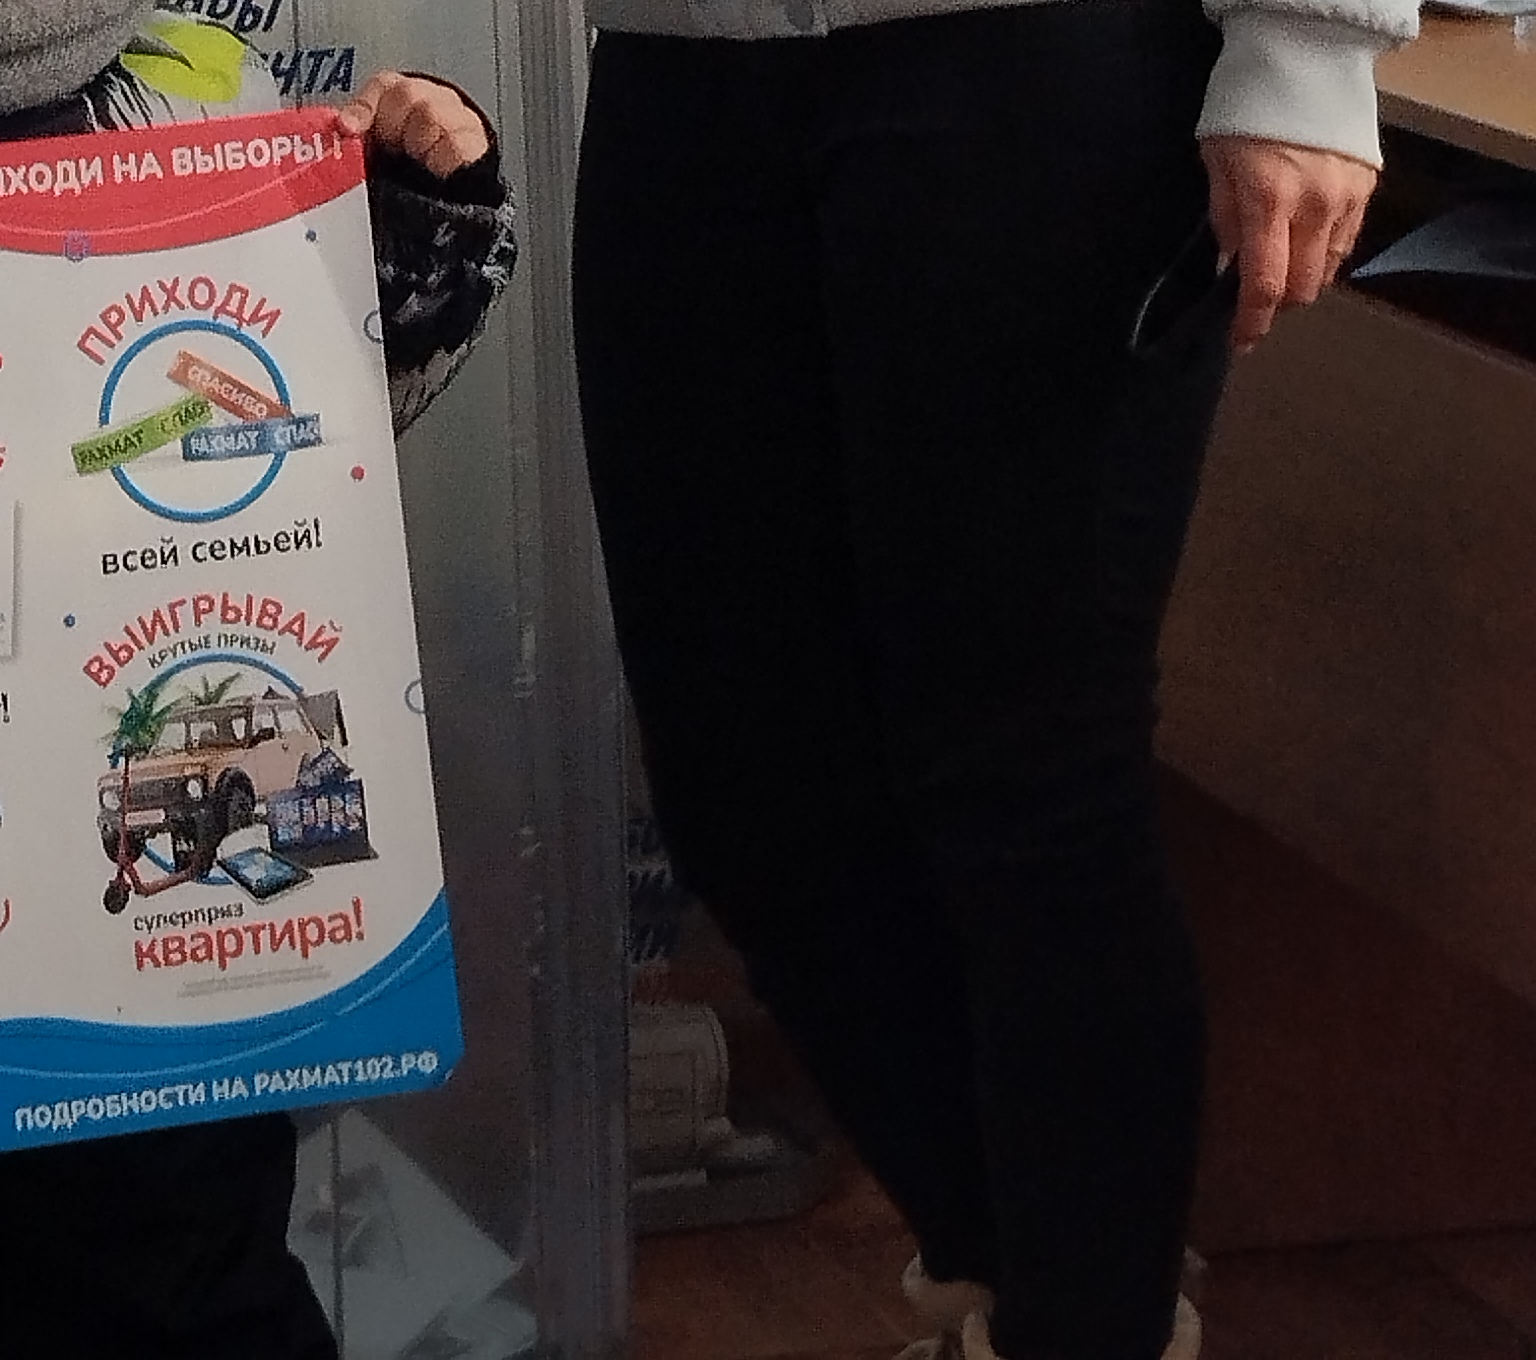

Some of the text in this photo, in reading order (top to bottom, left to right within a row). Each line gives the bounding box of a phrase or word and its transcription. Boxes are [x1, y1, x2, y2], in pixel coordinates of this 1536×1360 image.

[268, 46, 355, 96] ЧТА
[112, 150, 163, 184] НА
[76, 275, 282, 366] ПРИХОДИ
[75, 428, 145, 467] РАХМАТ
[189, 430, 260, 455] РАХМАТ
[101, 516, 322, 575] всей семьей!
[82, 590, 343, 689] ВЫИГРЫВАЙ
[147, 632, 277, 669] КРУТЫЕ ПРИЗЫ
[133, 901, 245, 935] суперприз
[133, 895, 366, 972] квартира!
[14, 1049, 440, 1133] ПОДРОБНОСТИ НА РАХМАТ102.РФ
